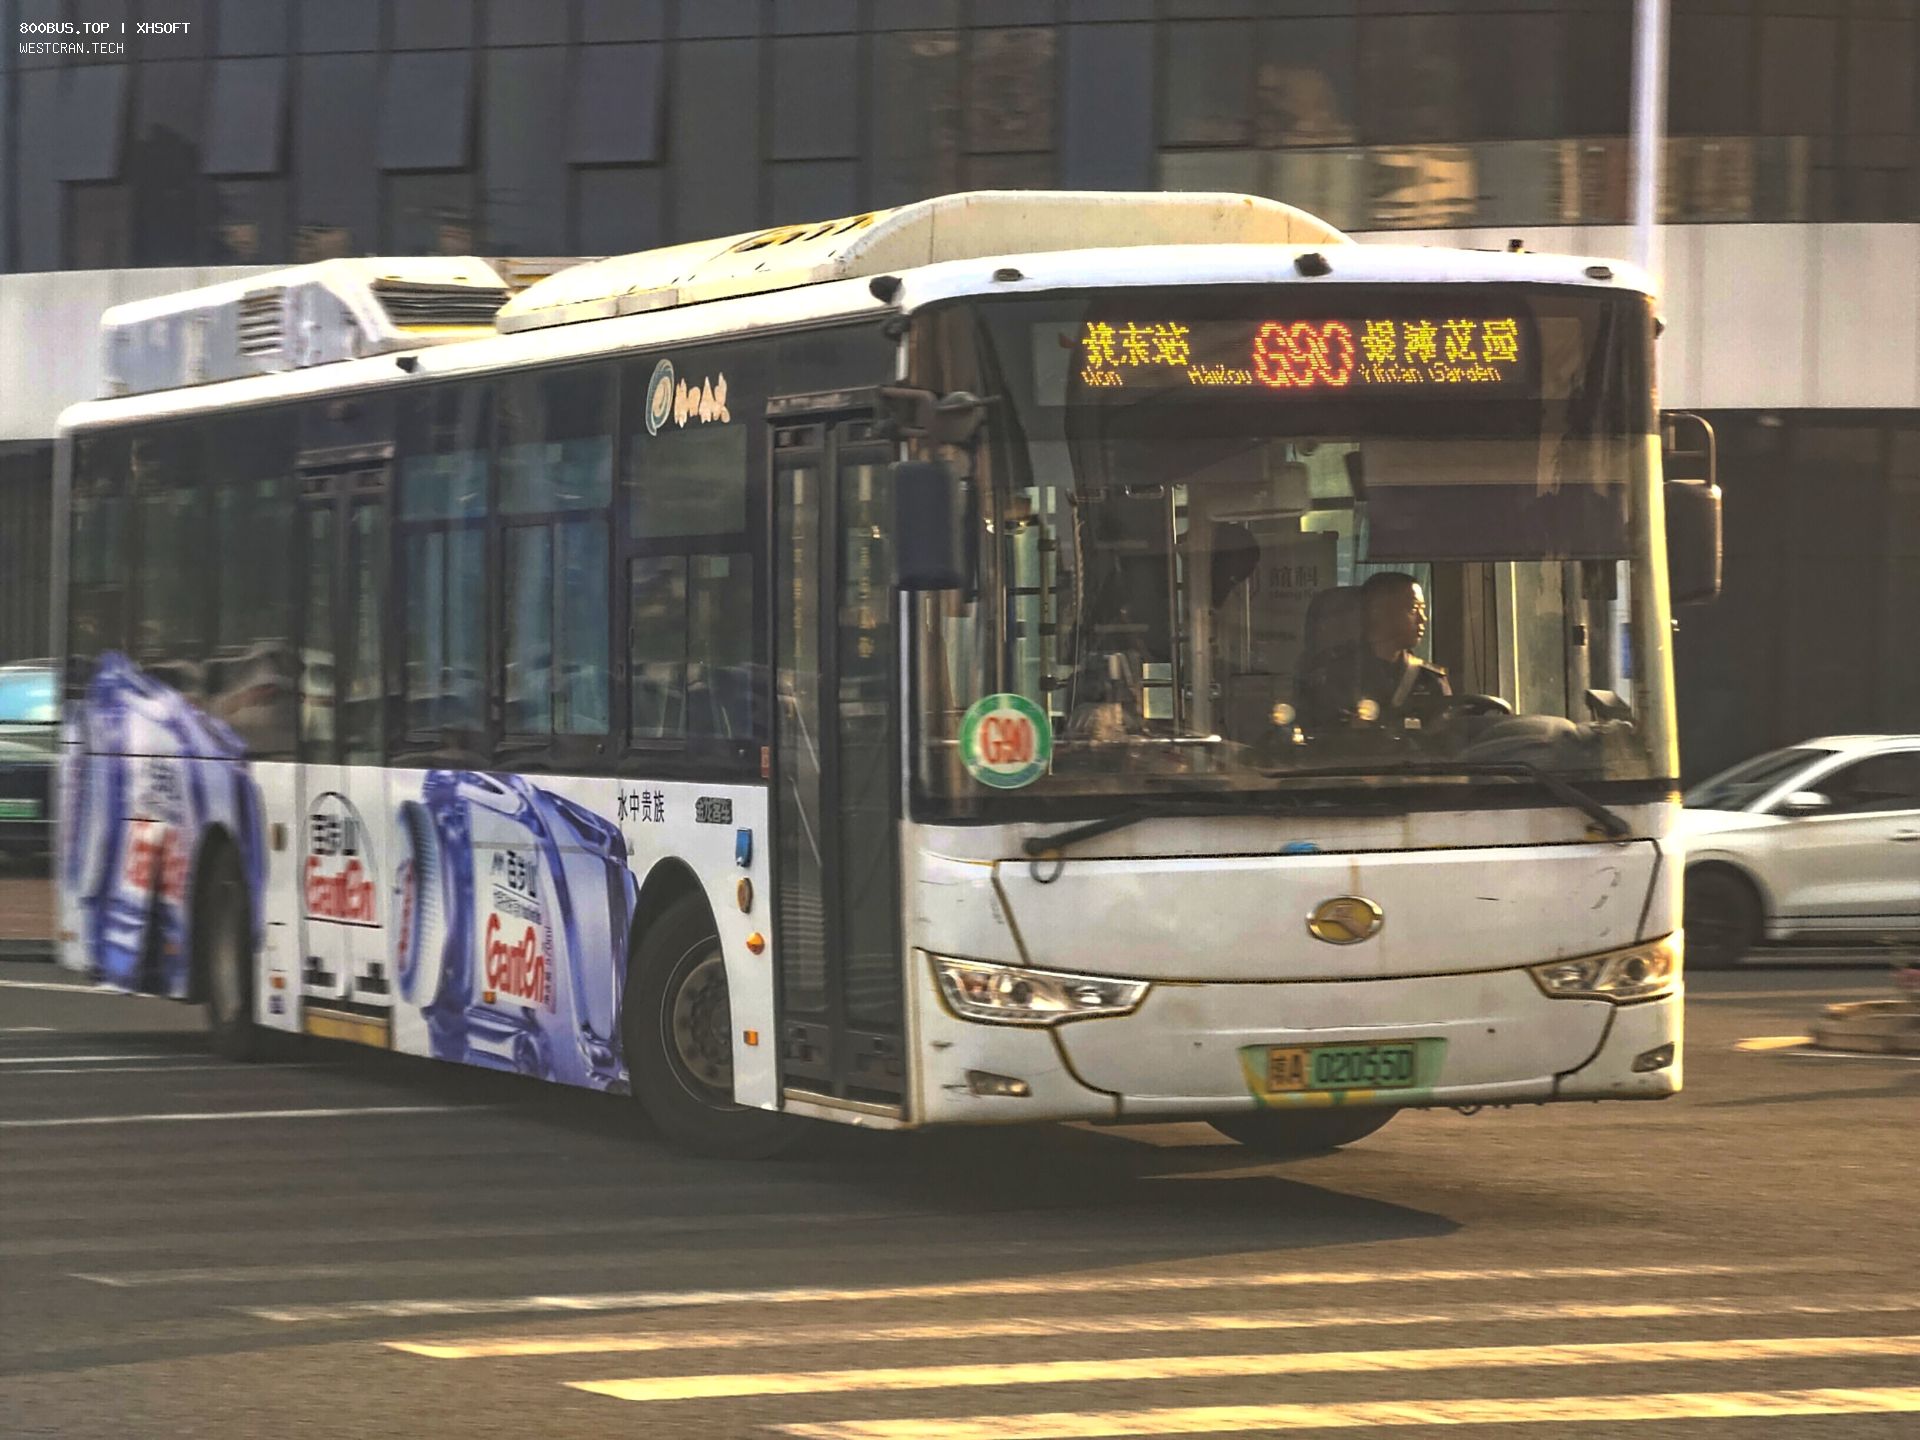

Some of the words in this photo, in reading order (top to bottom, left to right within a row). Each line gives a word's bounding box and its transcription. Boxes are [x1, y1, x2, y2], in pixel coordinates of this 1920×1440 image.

[1427, 361, 1503, 383] Garden
[617, 788, 665, 823] 水中贵族
